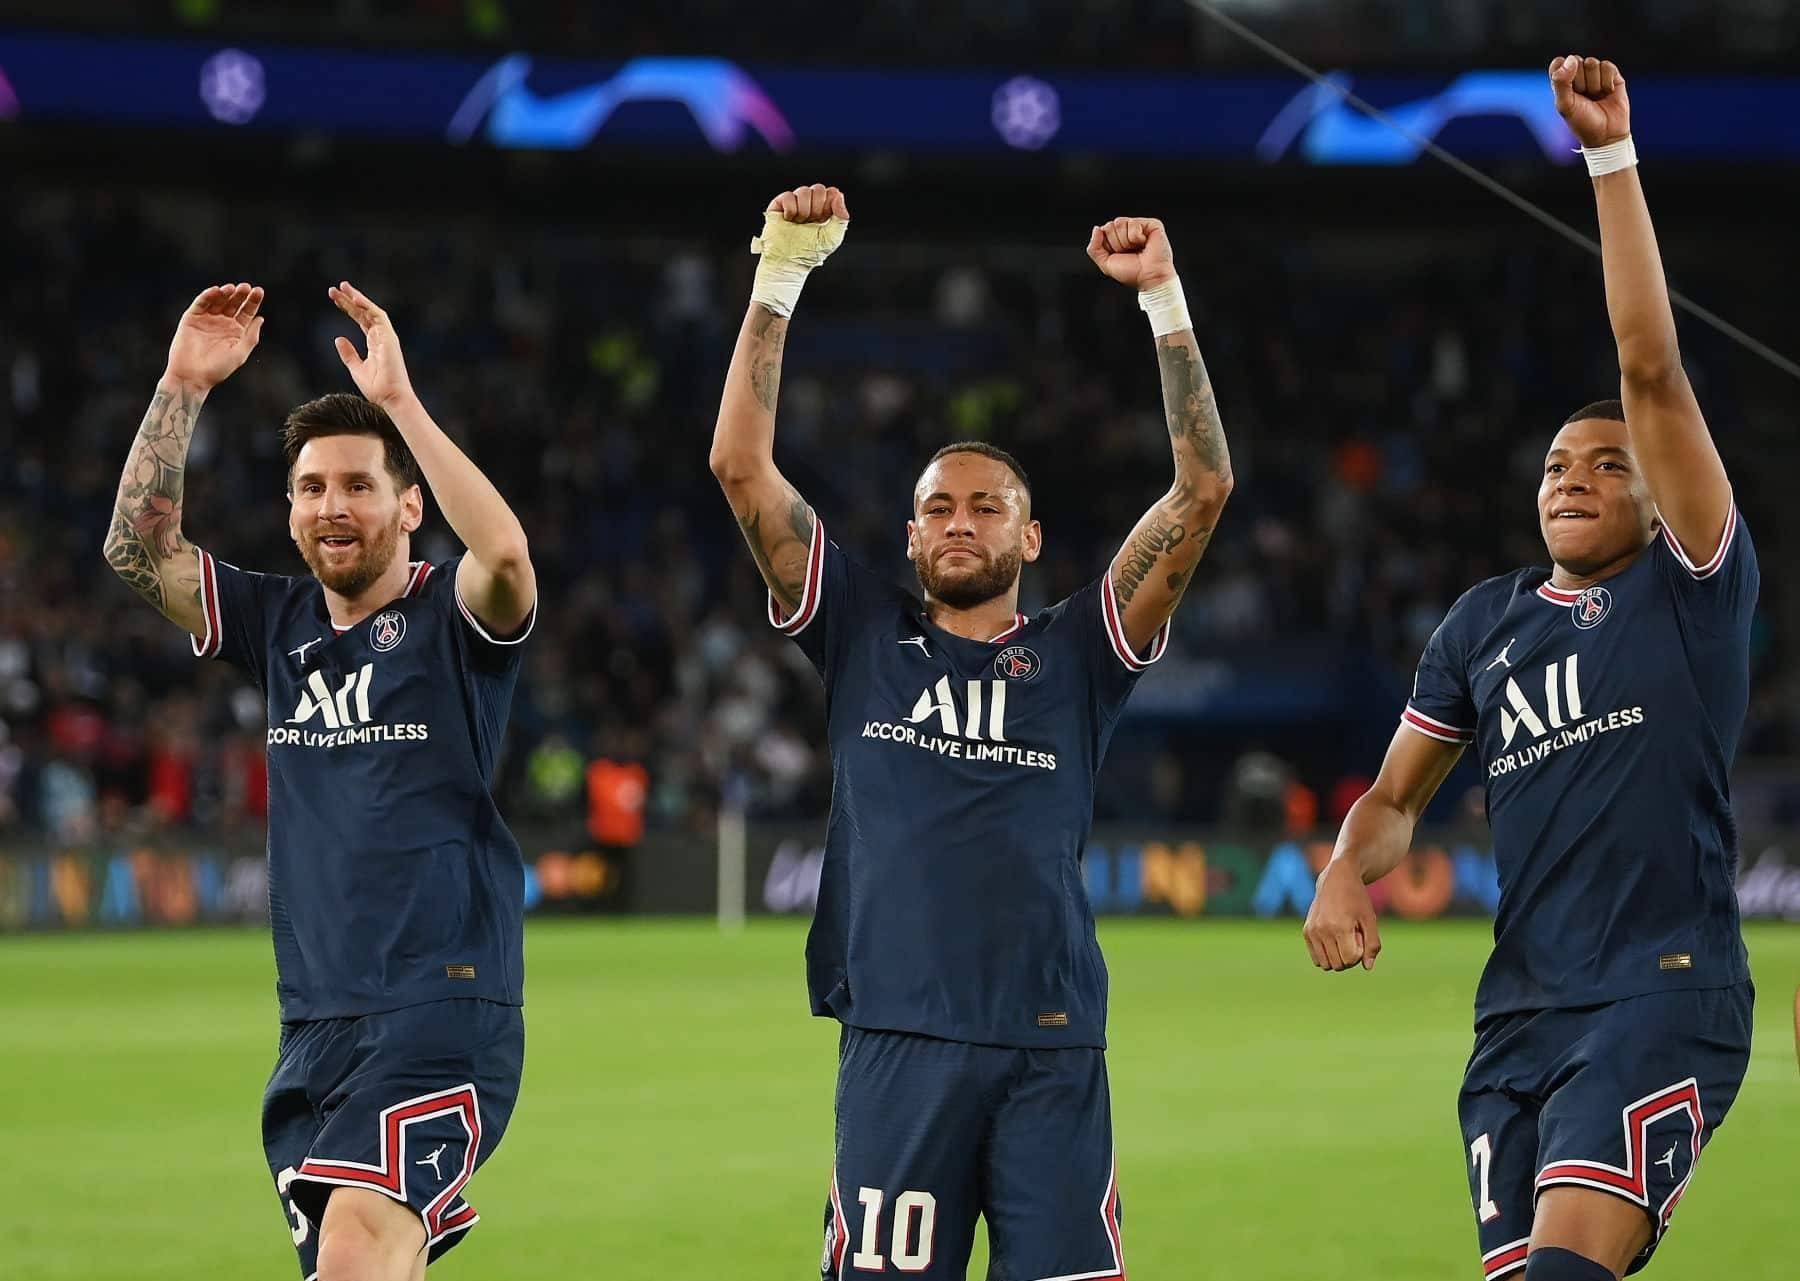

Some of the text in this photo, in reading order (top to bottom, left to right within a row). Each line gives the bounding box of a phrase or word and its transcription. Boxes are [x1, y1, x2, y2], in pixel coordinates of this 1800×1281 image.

[997, 648, 1025, 664] PARIS
[303, 729, 338, 748] LIVE
[338, 723, 428, 745] LIMITLESS
[861, 721, 1056, 771] ACCOR LIVE LIMITLESS
[1519, 740, 1551, 767] LIVE
[1552, 706, 1644, 750] LIMITLESS
[1470, 1133, 1500, 1224] 7
[853, 1186, 938, 1272] 10
